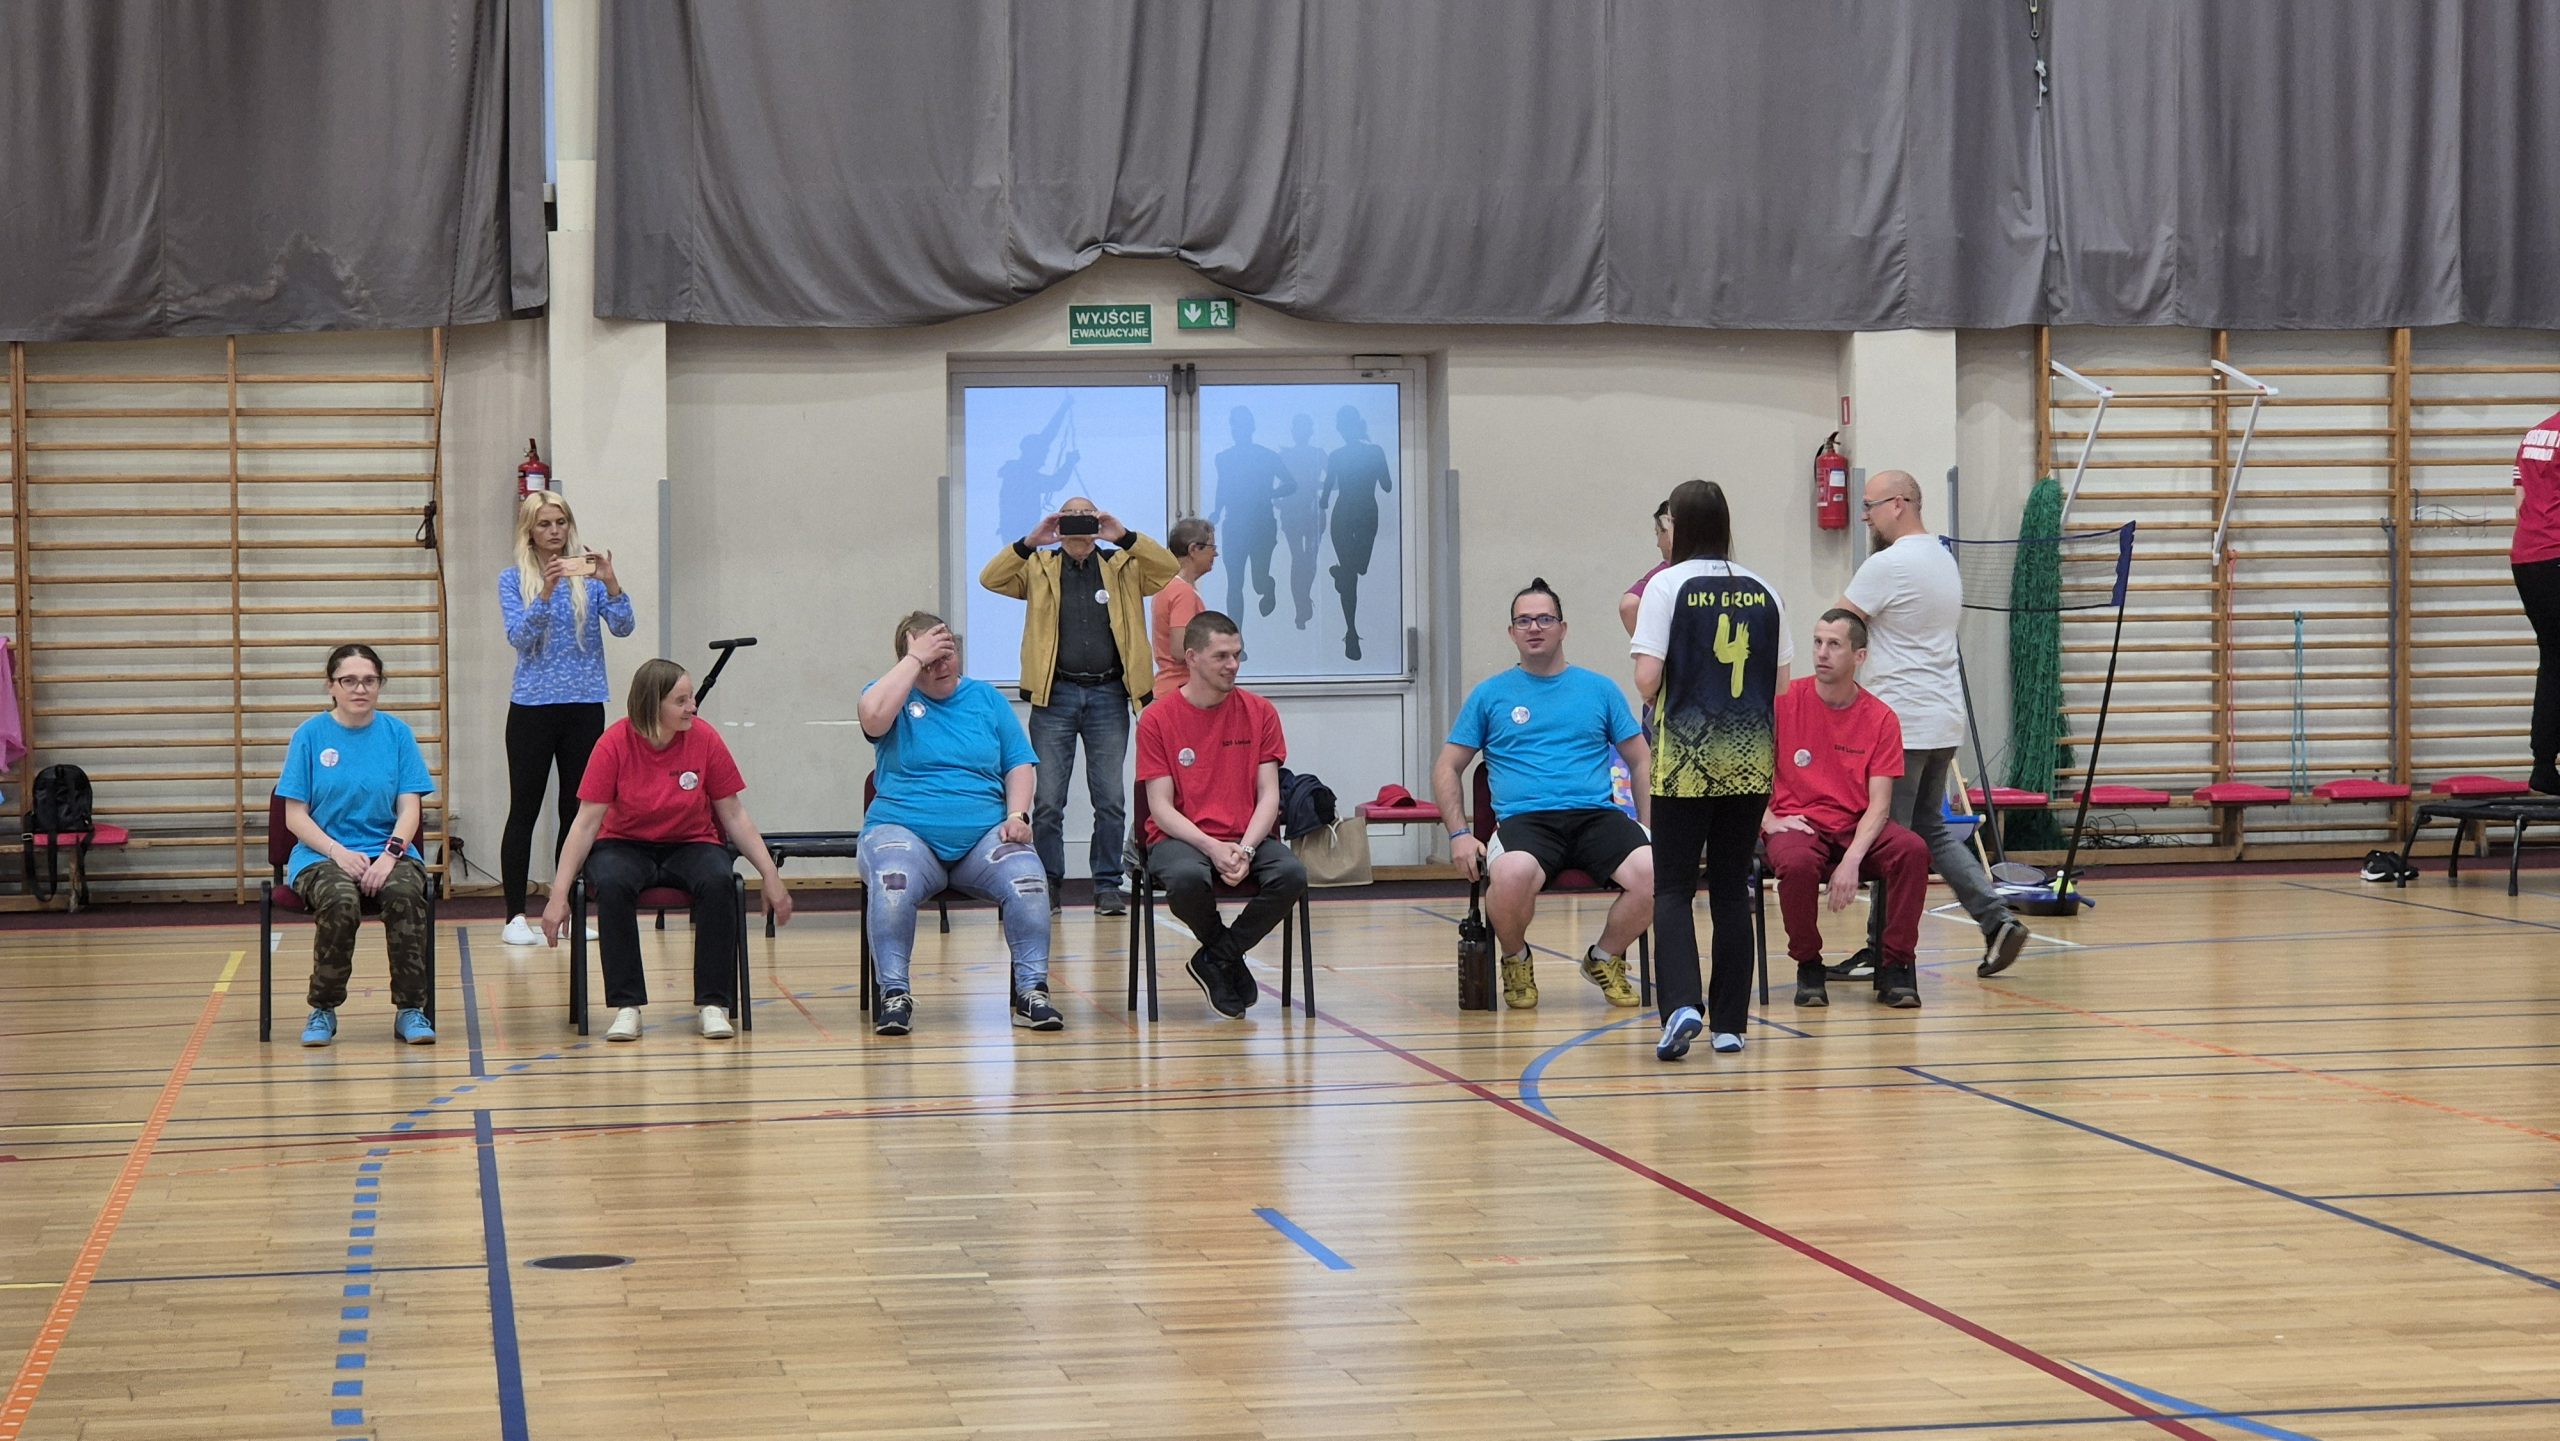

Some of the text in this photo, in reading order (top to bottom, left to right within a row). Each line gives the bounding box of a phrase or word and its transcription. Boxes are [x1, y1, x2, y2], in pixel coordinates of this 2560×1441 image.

[1075, 308, 1145, 325] WYJŚCIE
[1072, 328, 1149, 338] EWAKUACYJNE
[1687, 591, 1765, 607] UKS GROM
[1713, 613, 1751, 699] 4
